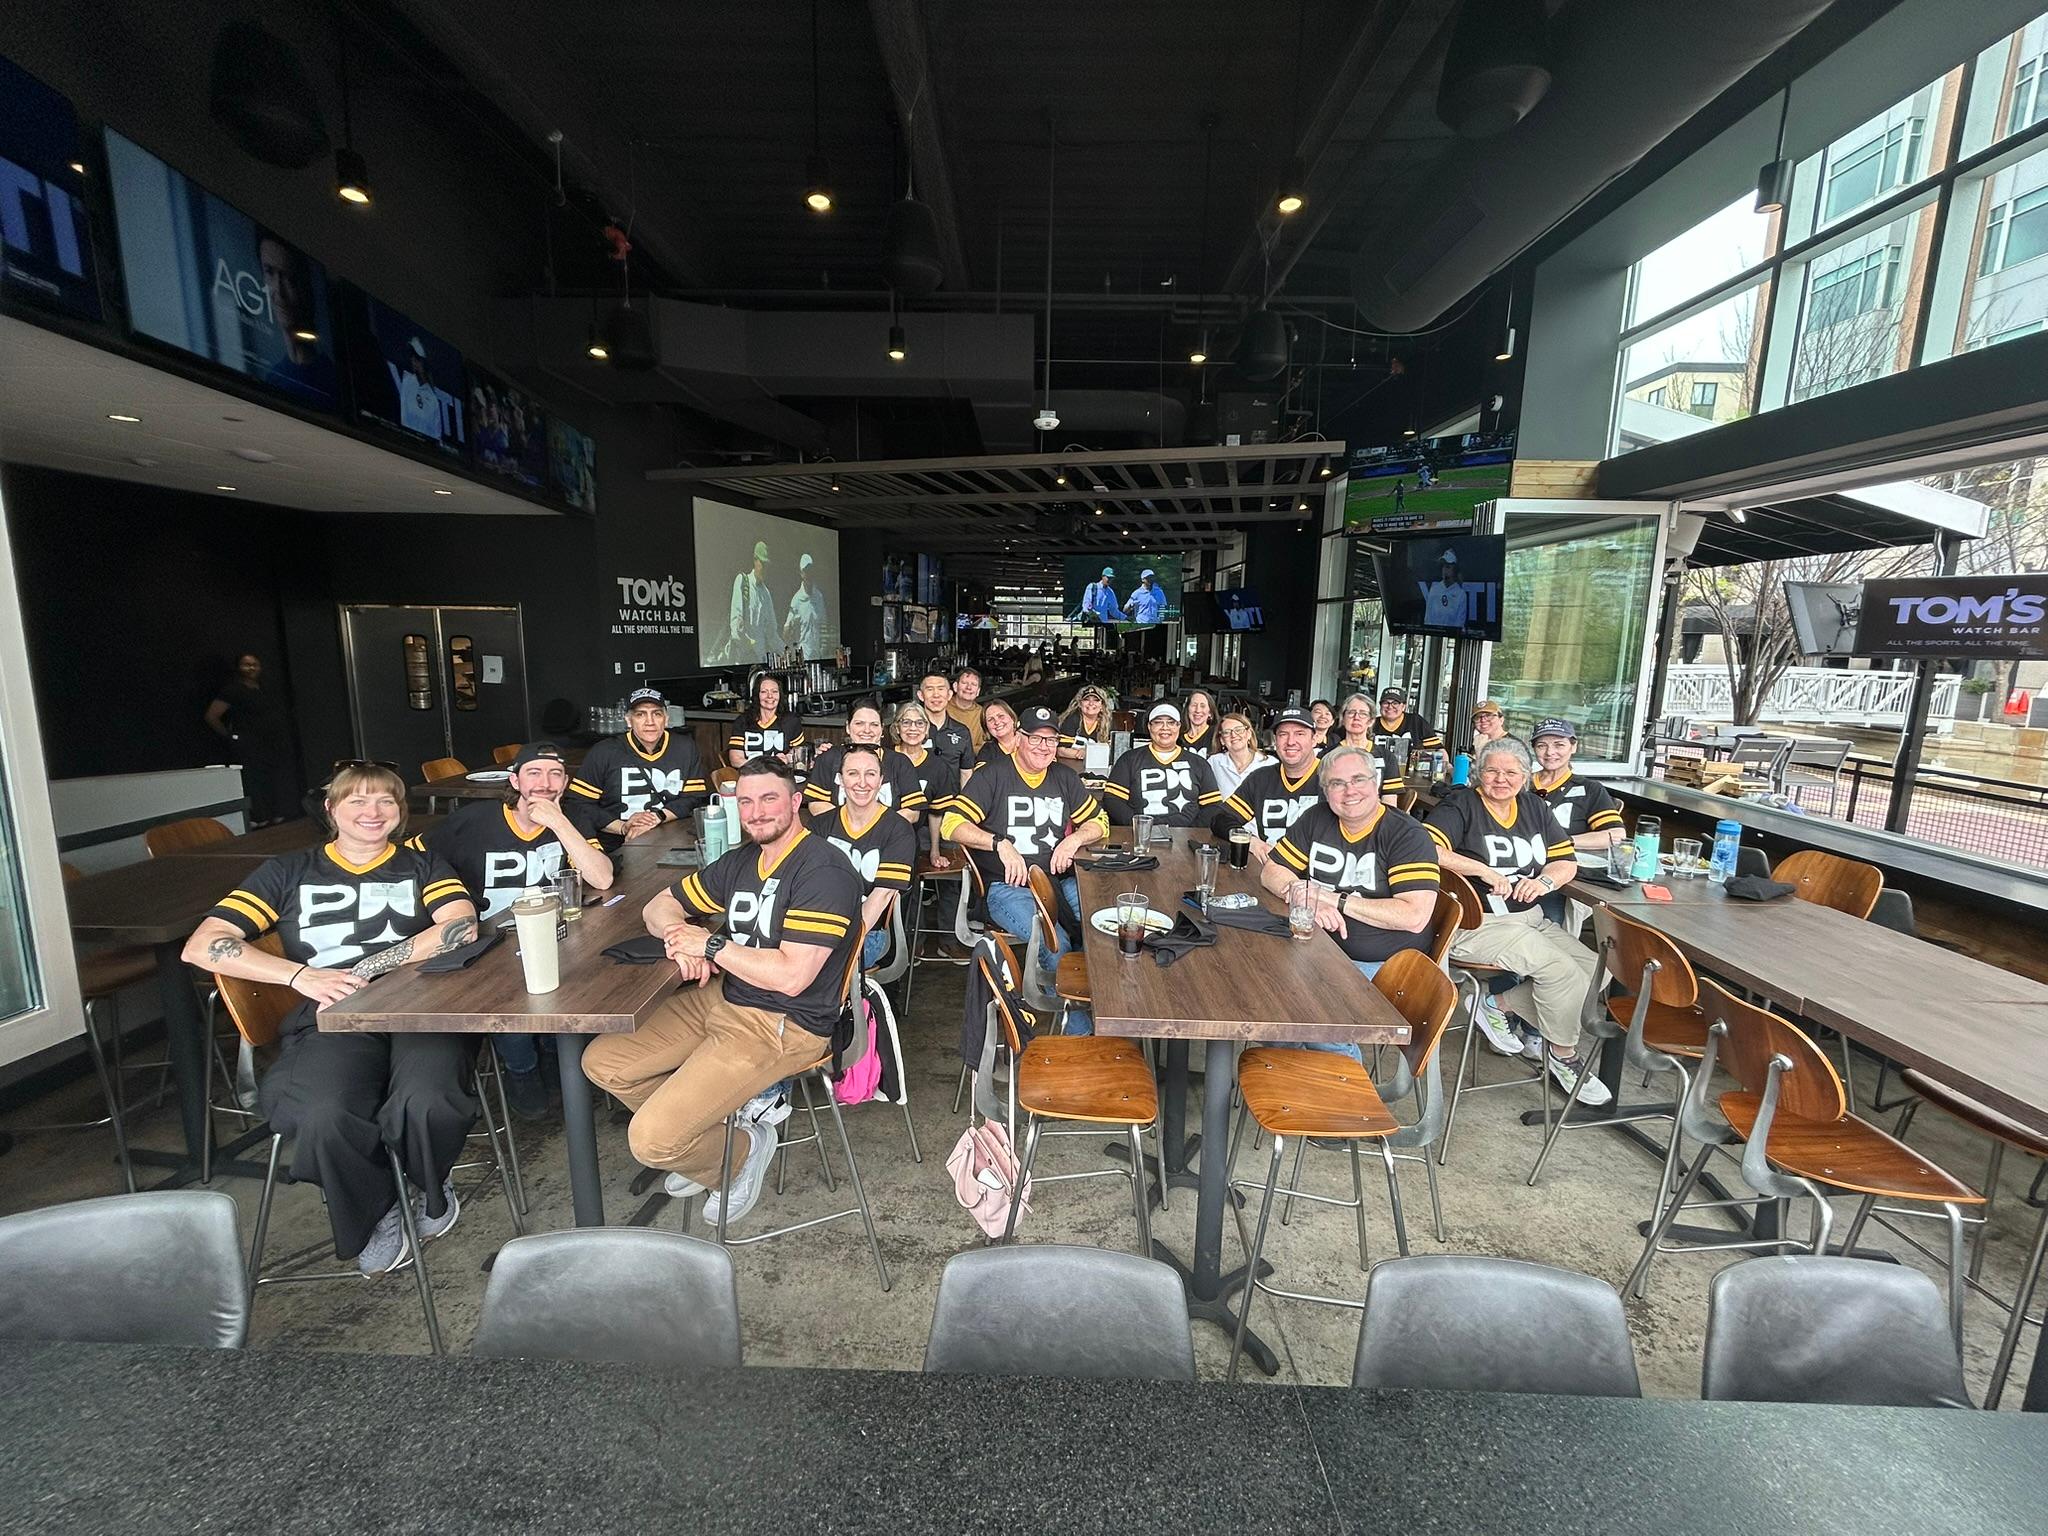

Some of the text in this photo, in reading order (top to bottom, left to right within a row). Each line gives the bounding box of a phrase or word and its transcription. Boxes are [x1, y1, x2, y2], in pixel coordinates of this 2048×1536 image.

[213, 258, 274, 324] AG1
[617, 575, 686, 608] TOM'S
[1888, 588, 2048, 625] TOM'S
[611, 625, 694, 634] ALL THE SPORTS ALL THE TIME
[619, 609, 686, 622] WATCH BAR
